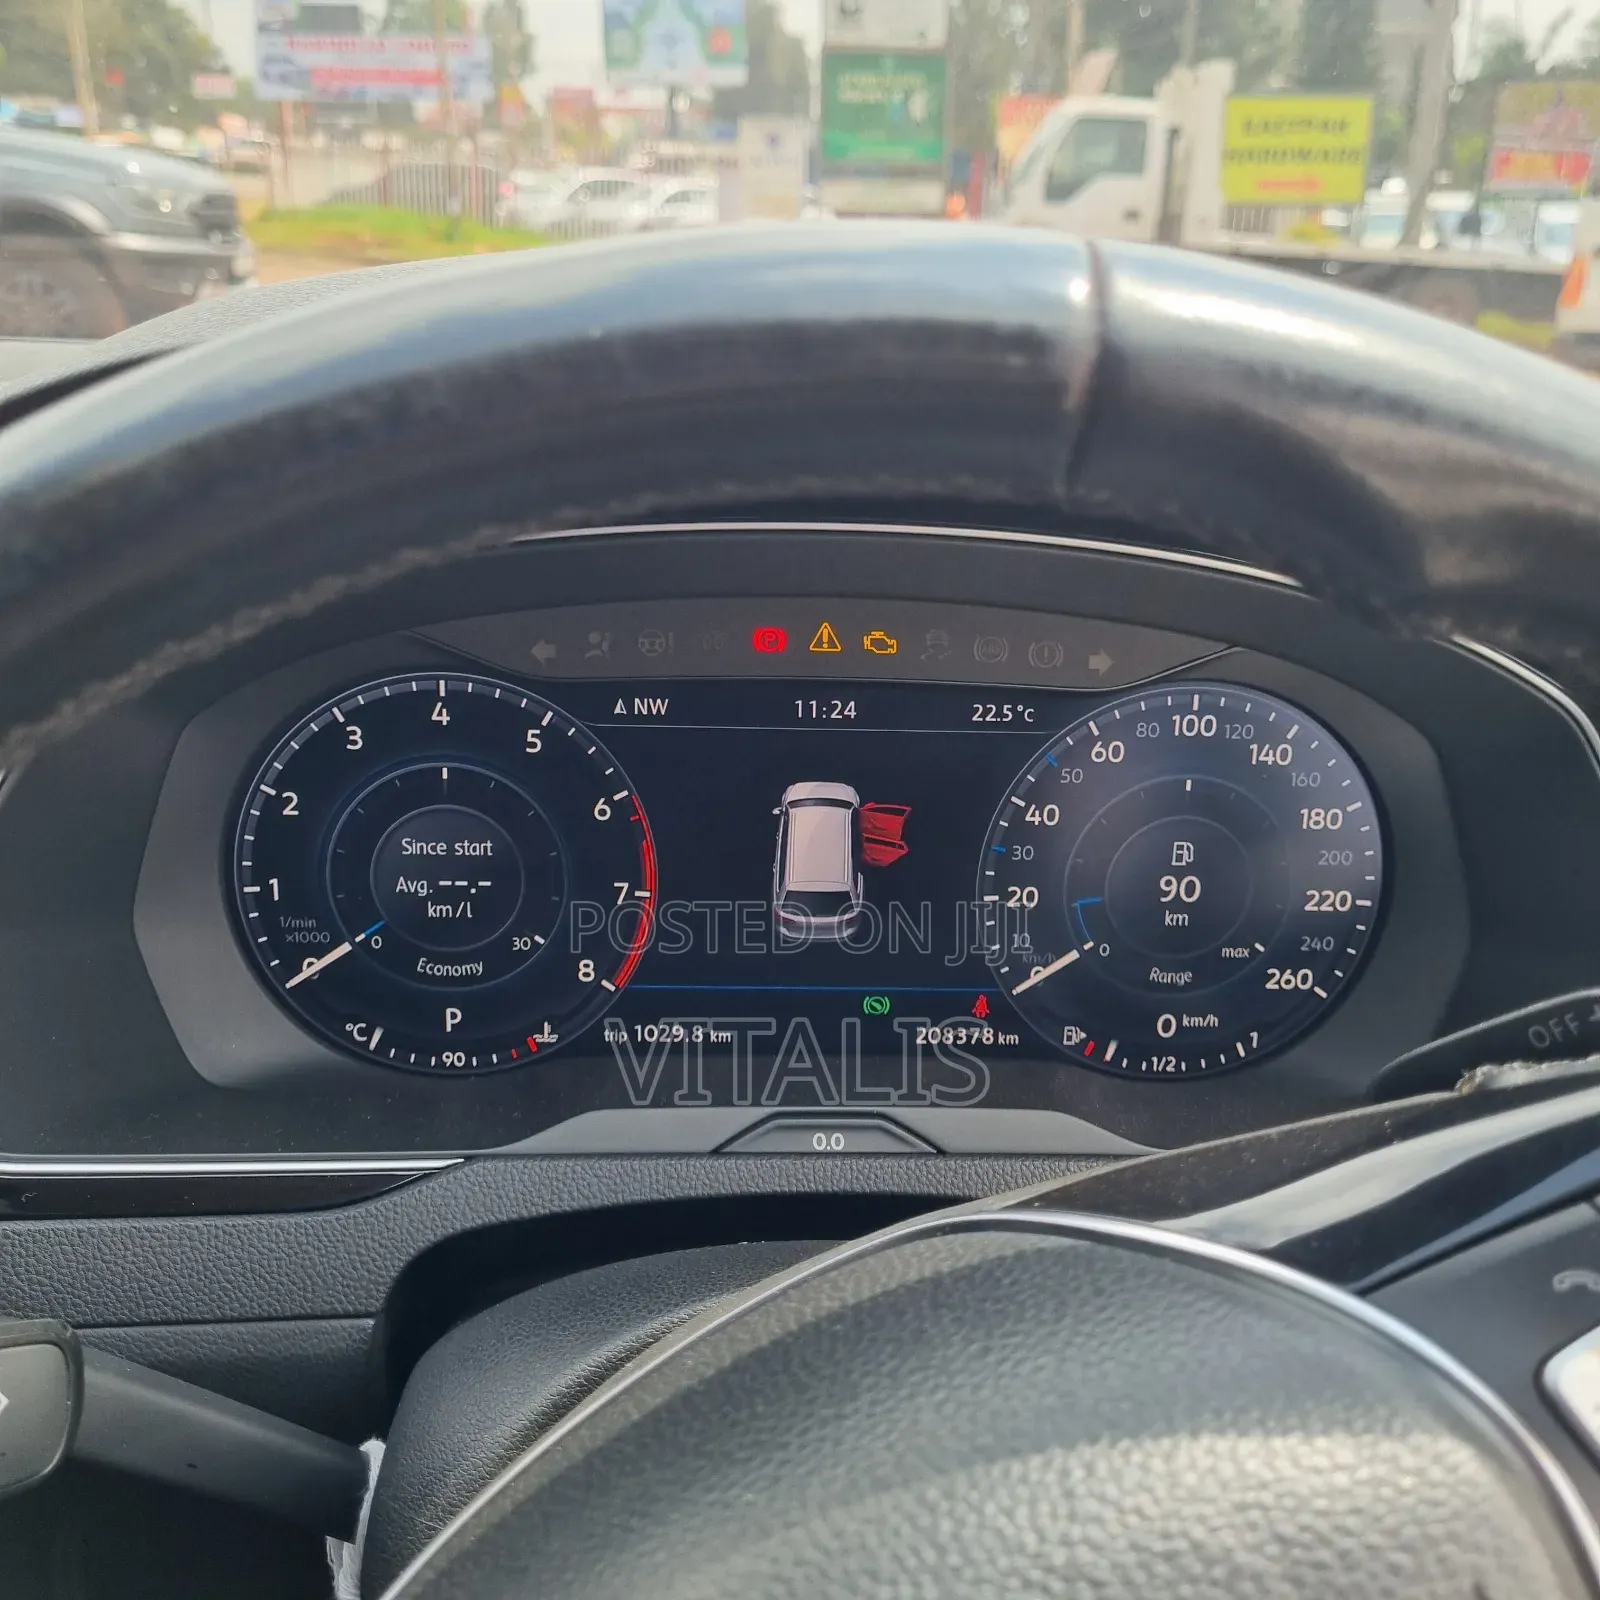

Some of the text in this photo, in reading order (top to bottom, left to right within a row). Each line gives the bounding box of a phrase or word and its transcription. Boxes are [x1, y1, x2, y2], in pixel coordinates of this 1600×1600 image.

[432, 702, 450, 725] 4
[635, 698, 668, 715] NW
[795, 700, 856, 718] 11:24
[1136, 723, 1159, 737] 80
[1173, 715, 1216, 736] 100
[1225, 724, 1254, 739] 120
[346, 726, 362, 749] 3
[526, 730, 542, 753] 5
[1091, 741, 1124, 762] 60
[1250, 744, 1292, 765] 140
[1061, 769, 1083, 783] 50
[1292, 772, 1321, 787] 160
[282, 792, 299, 815] 2
[594, 799, 611, 821] 6
[1025, 804, 1060, 826] 40
[1301, 808, 1343, 829] 180
[402, 838, 446, 855] Since
[455, 840, 492, 855] start
[1012, 846, 1034, 860] 30
[1319, 851, 1353, 866] 200
[269, 878, 279, 901] 1
[396, 877, 433, 896] Avg.
[614, 883, 629, 905] 7
[1160, 876, 1201, 902] 90
[1007, 887, 1038, 908] 20
[1304, 890, 1351, 911] 220
[428, 901, 472, 917] km/l
[1165, 910, 1188, 926] km
[280, 916, 316, 928] 1/min
[371, 935, 383, 949] 0
[513, 937, 531, 950] 30
[1012, 932, 1032, 948] 10
[1301, 936, 1334, 951] 240
[1100, 944, 1109, 956] 0
[1222, 948, 1249, 958] max
[417, 958, 482, 976] Economy
[578, 960, 594, 982] 8
[1150, 967, 1192, 985] Range
[1265, 968, 1313, 991] 260
[446, 1008, 461, 1032] P
[1157, 1014, 1218, 1037] 0 km/h
[346, 1023, 367, 1041] °C
[602, 1023, 732, 1045] trip 1029.8 km
[915, 1025, 1020, 1047] 208378 km
[1527, 1012, 1580, 1049] OFF
[442, 1052, 465, 1067] 90
[1151, 1056, 1176, 1072] 1/2
[812, 1131, 846, 1152] 0.0
